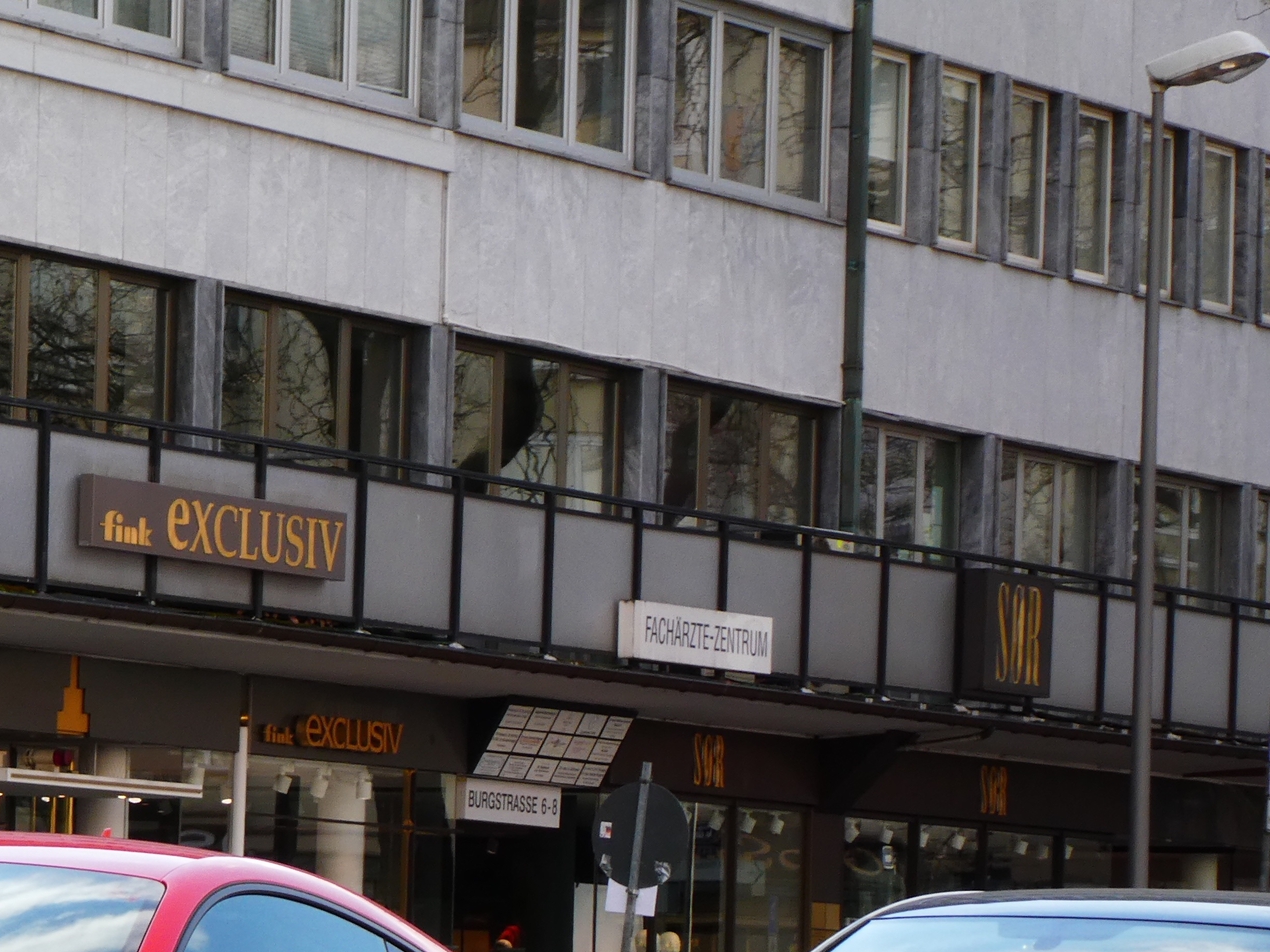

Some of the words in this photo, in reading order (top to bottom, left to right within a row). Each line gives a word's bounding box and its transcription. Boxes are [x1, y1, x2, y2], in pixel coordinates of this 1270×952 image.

[100, 510, 152, 547] fink
[645, 615, 768, 657] FACHÄRZTE-ZENTRUM
[264, 723, 294, 746] fink
[468, 790, 538, 813] BURGSTRASSE
